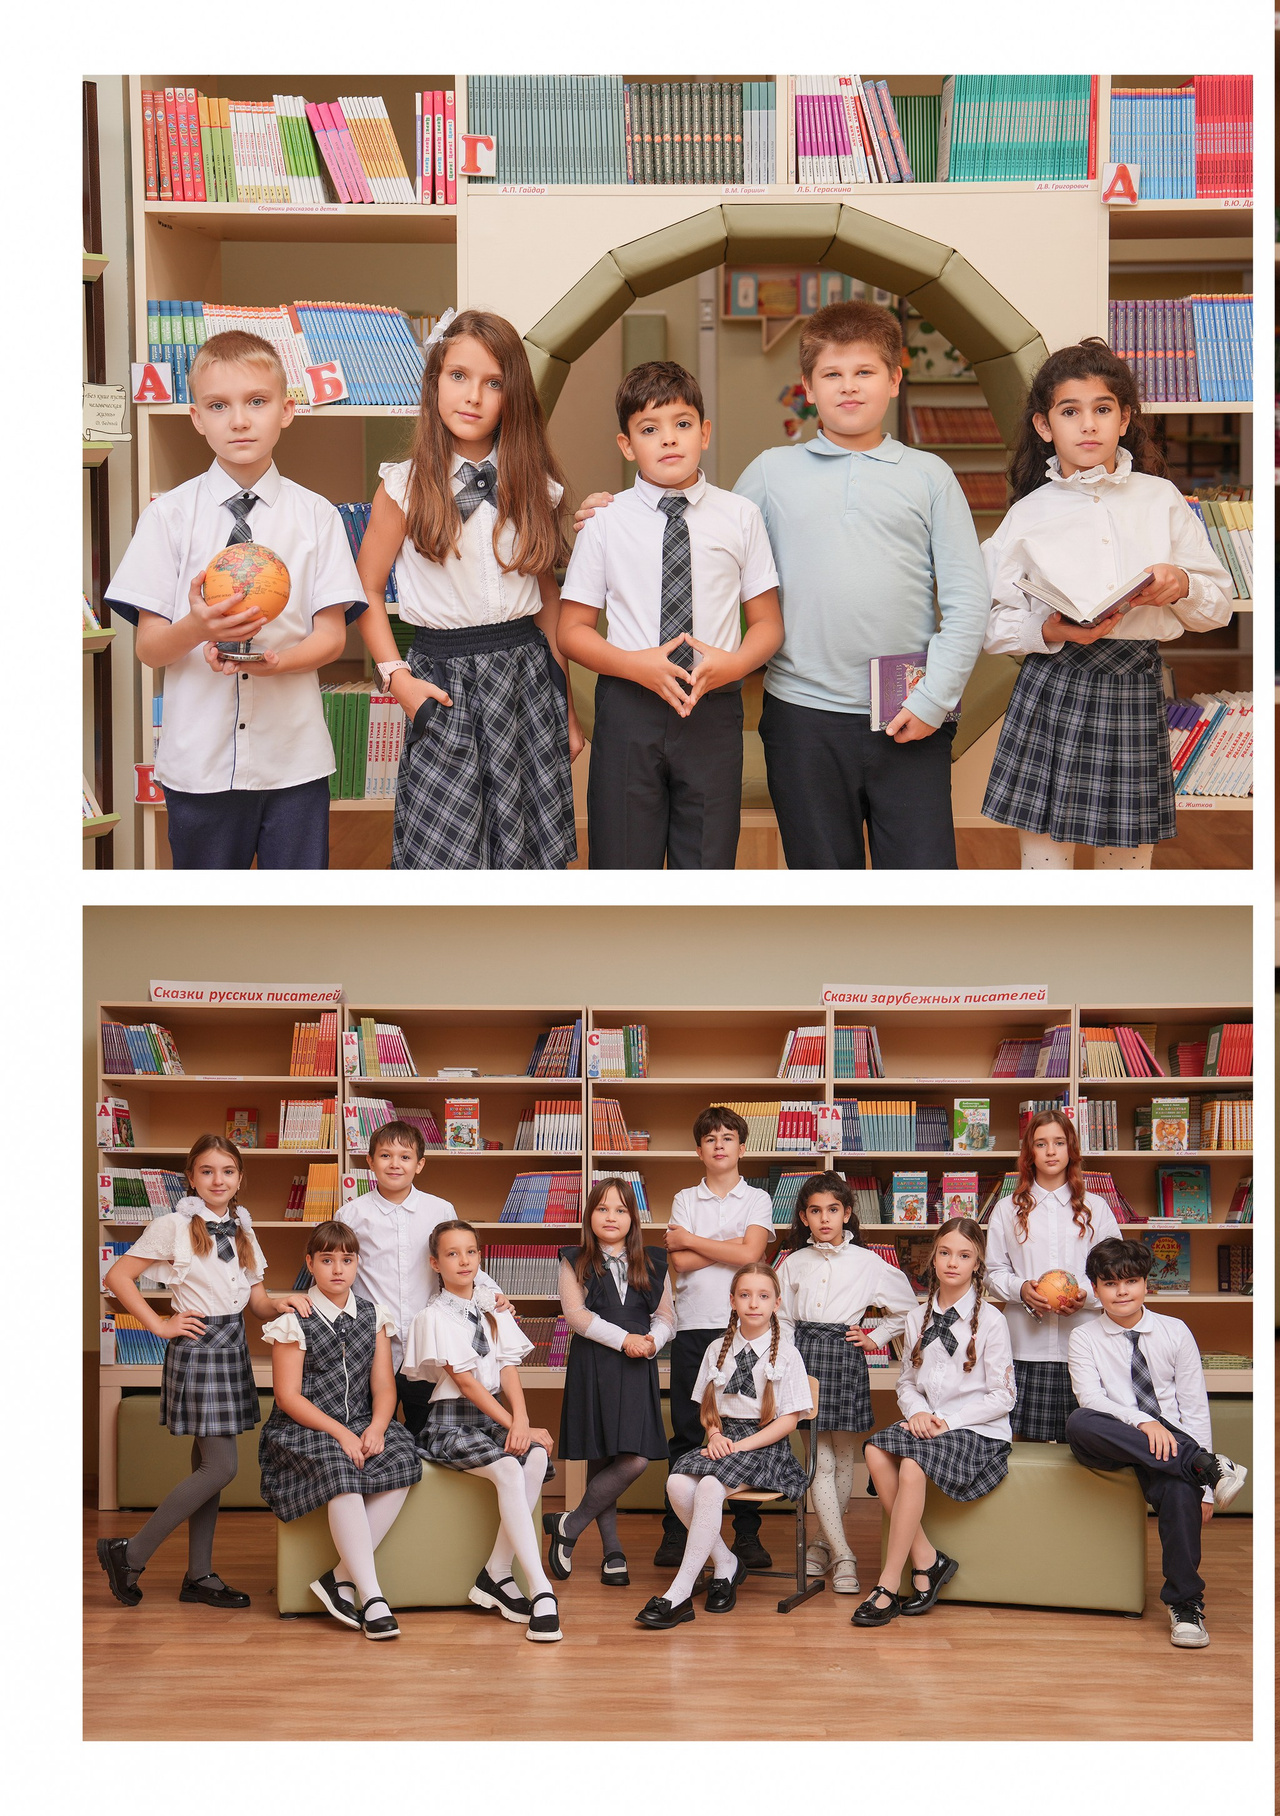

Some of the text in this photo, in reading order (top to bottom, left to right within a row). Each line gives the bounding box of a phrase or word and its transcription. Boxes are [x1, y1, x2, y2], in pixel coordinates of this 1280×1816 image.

[460, 133, 494, 174] Г
[502, 185, 546, 194] А.П. Гайдар
[796, 185, 852, 193] Л.Б. Гераскина
[1102, 163, 1138, 205] А
[134, 363, 171, 401] А
[305, 361, 343, 404] Б
[153, 986, 341, 1003] Сказки русских писателей
[823, 989, 1046, 1006] Сказки зарубежных писателей
[344, 1033, 357, 1046] К
[588, 1033, 600, 1046] С
[97, 1104, 111, 1117] А
[345, 1105, 358, 1118] М
[819, 1106, 831, 1119] Т
[831, 1108, 841, 1121] А
[100, 1175, 112, 1188] Б
[343, 1176, 356, 1189] О
[101, 1248, 112, 1261] Г
